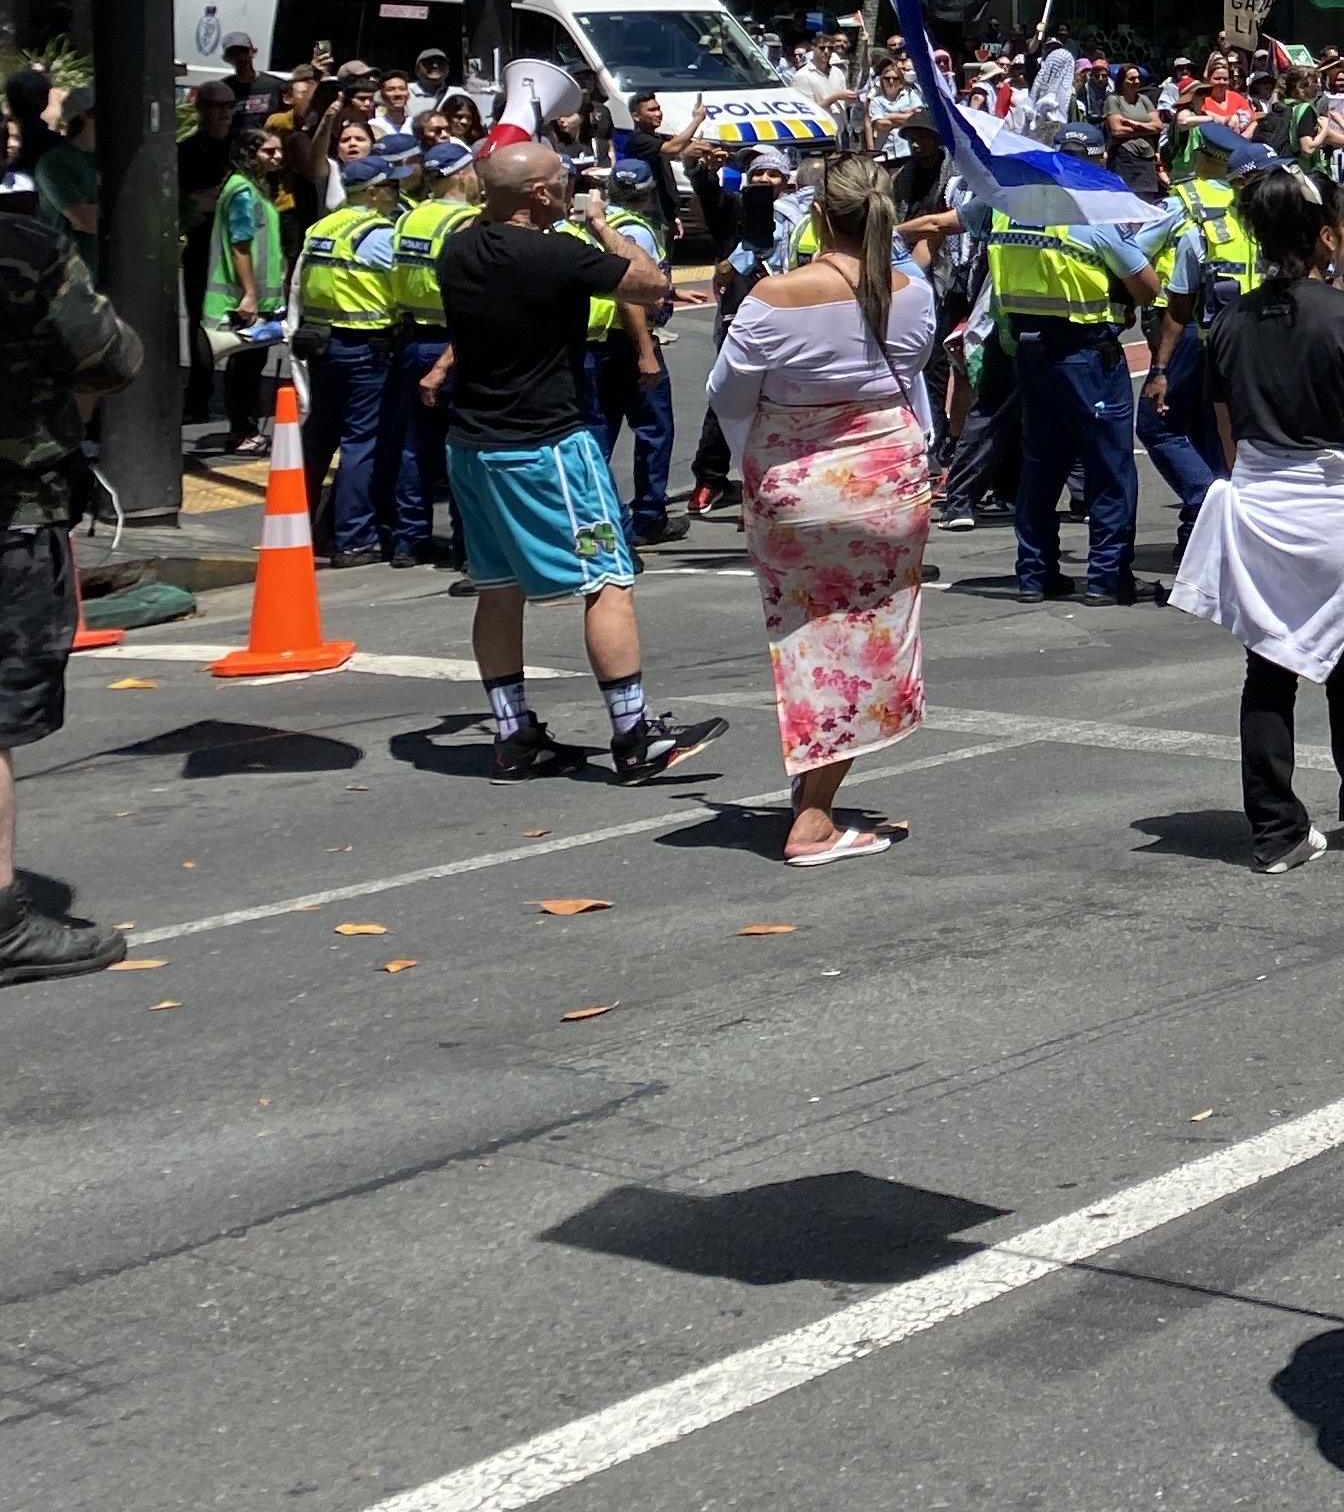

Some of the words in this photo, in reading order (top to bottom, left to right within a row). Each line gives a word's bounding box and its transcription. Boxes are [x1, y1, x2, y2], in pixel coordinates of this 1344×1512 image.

[1235, 15, 1261, 35] LI
[704, 101, 815, 120] POLICE
[400, 240, 430, 252] POLICE
